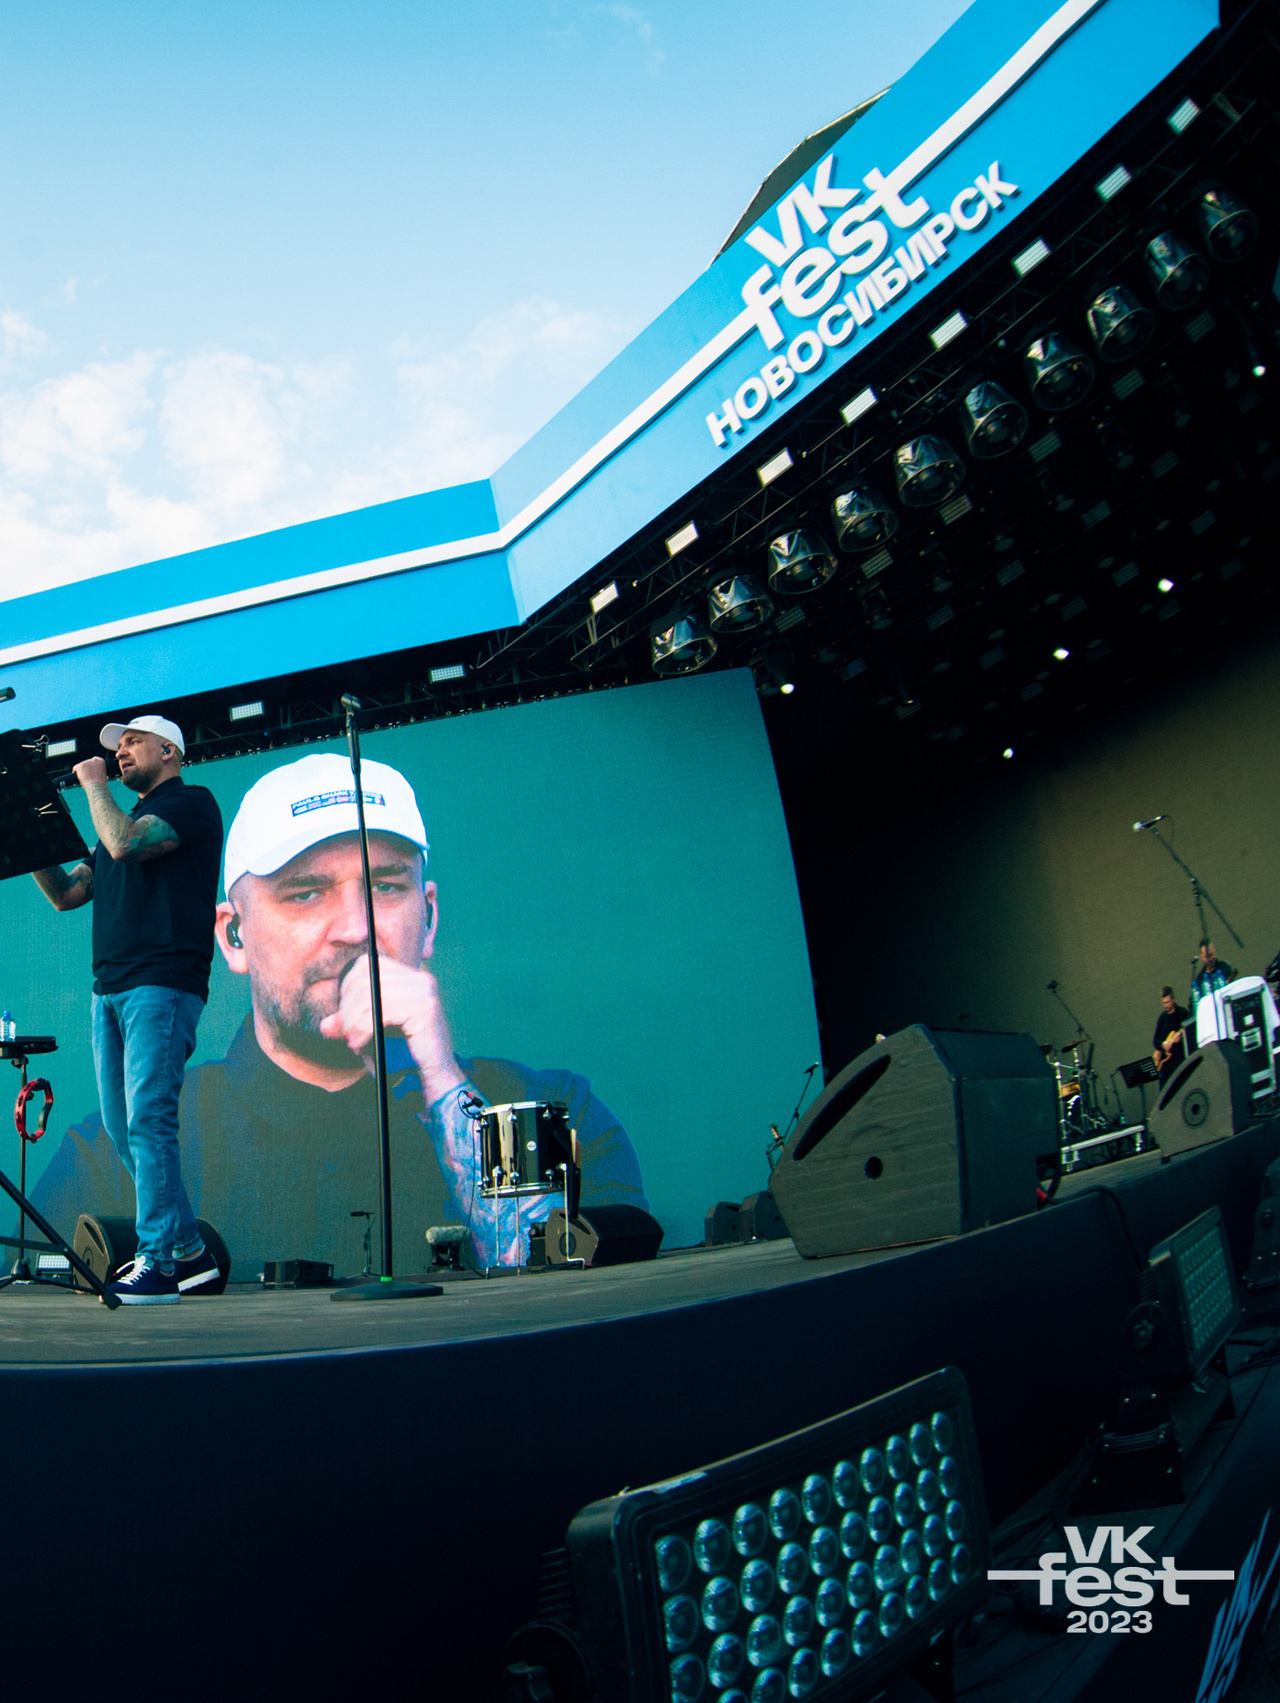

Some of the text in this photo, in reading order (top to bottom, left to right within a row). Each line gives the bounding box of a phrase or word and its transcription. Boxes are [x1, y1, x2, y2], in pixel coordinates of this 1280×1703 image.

[741, 166, 931, 351] fest
[744, 153, 862, 267] VK
[705, 160, 1019, 448] НОВОСИБИРСК
